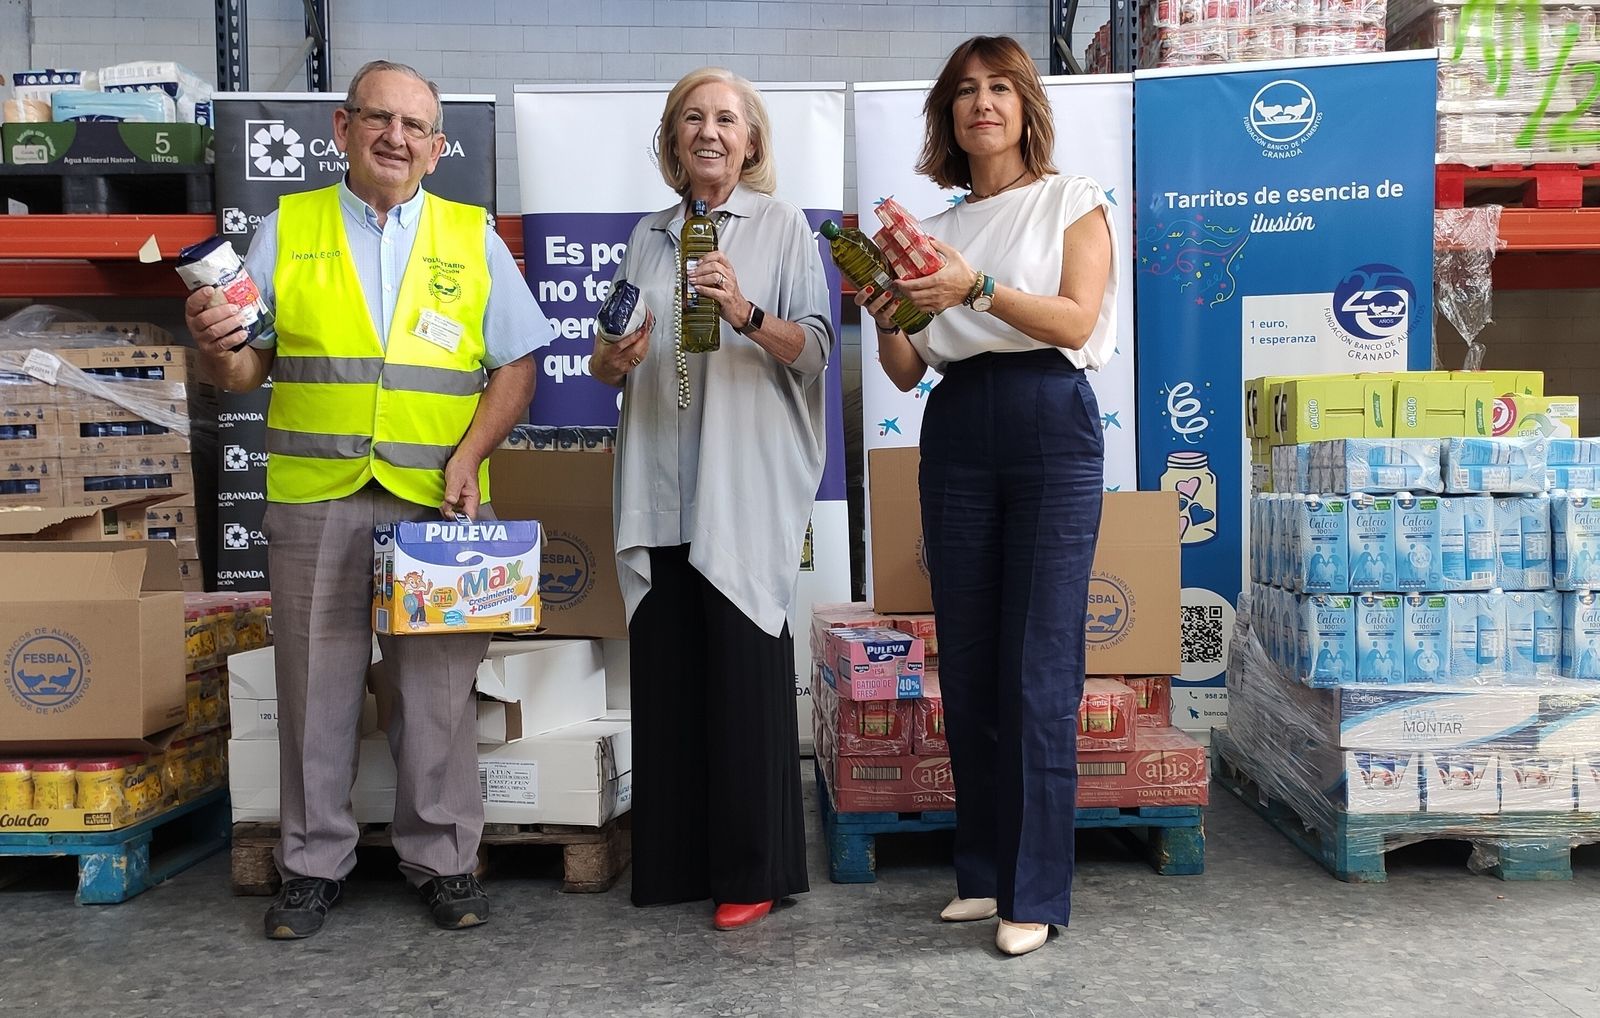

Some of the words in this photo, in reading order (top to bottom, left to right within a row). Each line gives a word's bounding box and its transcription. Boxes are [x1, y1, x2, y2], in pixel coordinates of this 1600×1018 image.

[1243, 116, 1266, 147] FUNDACIÓN
[1300, 112, 1323, 144] ALIMENTOS
[155, 132, 171, 154] 5
[151, 155, 178, 164] litros
[1262, 148, 1303, 159] GRANADA
[319, 162, 349, 172] FUN
[1164, 190, 1248, 209] Tarritos
[1254, 186, 1280, 205] de
[1286, 182, 1369, 203] esencia
[1376, 179, 1404, 198] de
[1250, 211, 1316, 234] ilusión
[545, 236, 584, 266] Es
[591, 242, 628, 272] po
[422, 256, 465, 269] VOLUTARIO
[539, 280, 578, 302] no
[583, 274, 612, 302] te
[1250, 320, 1255, 328] 1
[1259, 320, 1288, 329] euro,
[1324, 307, 1352, 346] FUNDACIÓN
[1354, 341, 1381, 350] BANCO
[1385, 341, 1395, 349] DE
[1397, 304, 1426, 343] ALIMENTOS
[1250, 336, 1255, 344] 1
[1259, 334, 1316, 346] esperanza
[1347, 349, 1400, 361] GRANADA
[1308, 399, 1320, 430] CALCIO
[1407, 397, 1417, 428] CALCIO
[1309, 518, 1338, 529] Calcio
[1356, 515, 1386, 527] Calcio
[1402, 515, 1432, 527] Calcio
[425, 523, 508, 542] PULEVA
[542, 554, 579, 564] ESBAL
[461, 560, 524, 598] Max
[1100, 571, 1136, 606] ALIMENTOS
[433, 594, 453, 602] DHA
[468, 588, 514, 606] Crecimiento
[1088, 594, 1118, 604] SBAL
[1316, 612, 1346, 624] Calcio
[1365, 612, 1395, 624] Calcio
[1411, 612, 1441, 624] Calcio
[1582, 612, 1600, 623] Calc
[1100, 617, 1136, 650] ALIMENTOS
[4, 631, 31, 666] BANCOS
[51, 628, 91, 666] ALIMENTOS
[867, 645, 905, 655] PULEVA
[23, 653, 72, 663] FESBAL
[856, 680, 880, 689] BATIDO
[900, 679, 920, 691] 40%
[4, 678, 32, 710] BANCOS
[52, 677, 91, 714] ALIMENTOS
[856, 690, 878, 698] FRESA
[1404, 721, 1462, 734] MONTAR
[1145, 758, 1190, 783] apis
[920, 767, 953, 788] ap
[1137, 789, 1172, 797] TOMATE
[1174, 787, 1199, 796] FRITO
[1, 814, 49, 828] ColaCao
